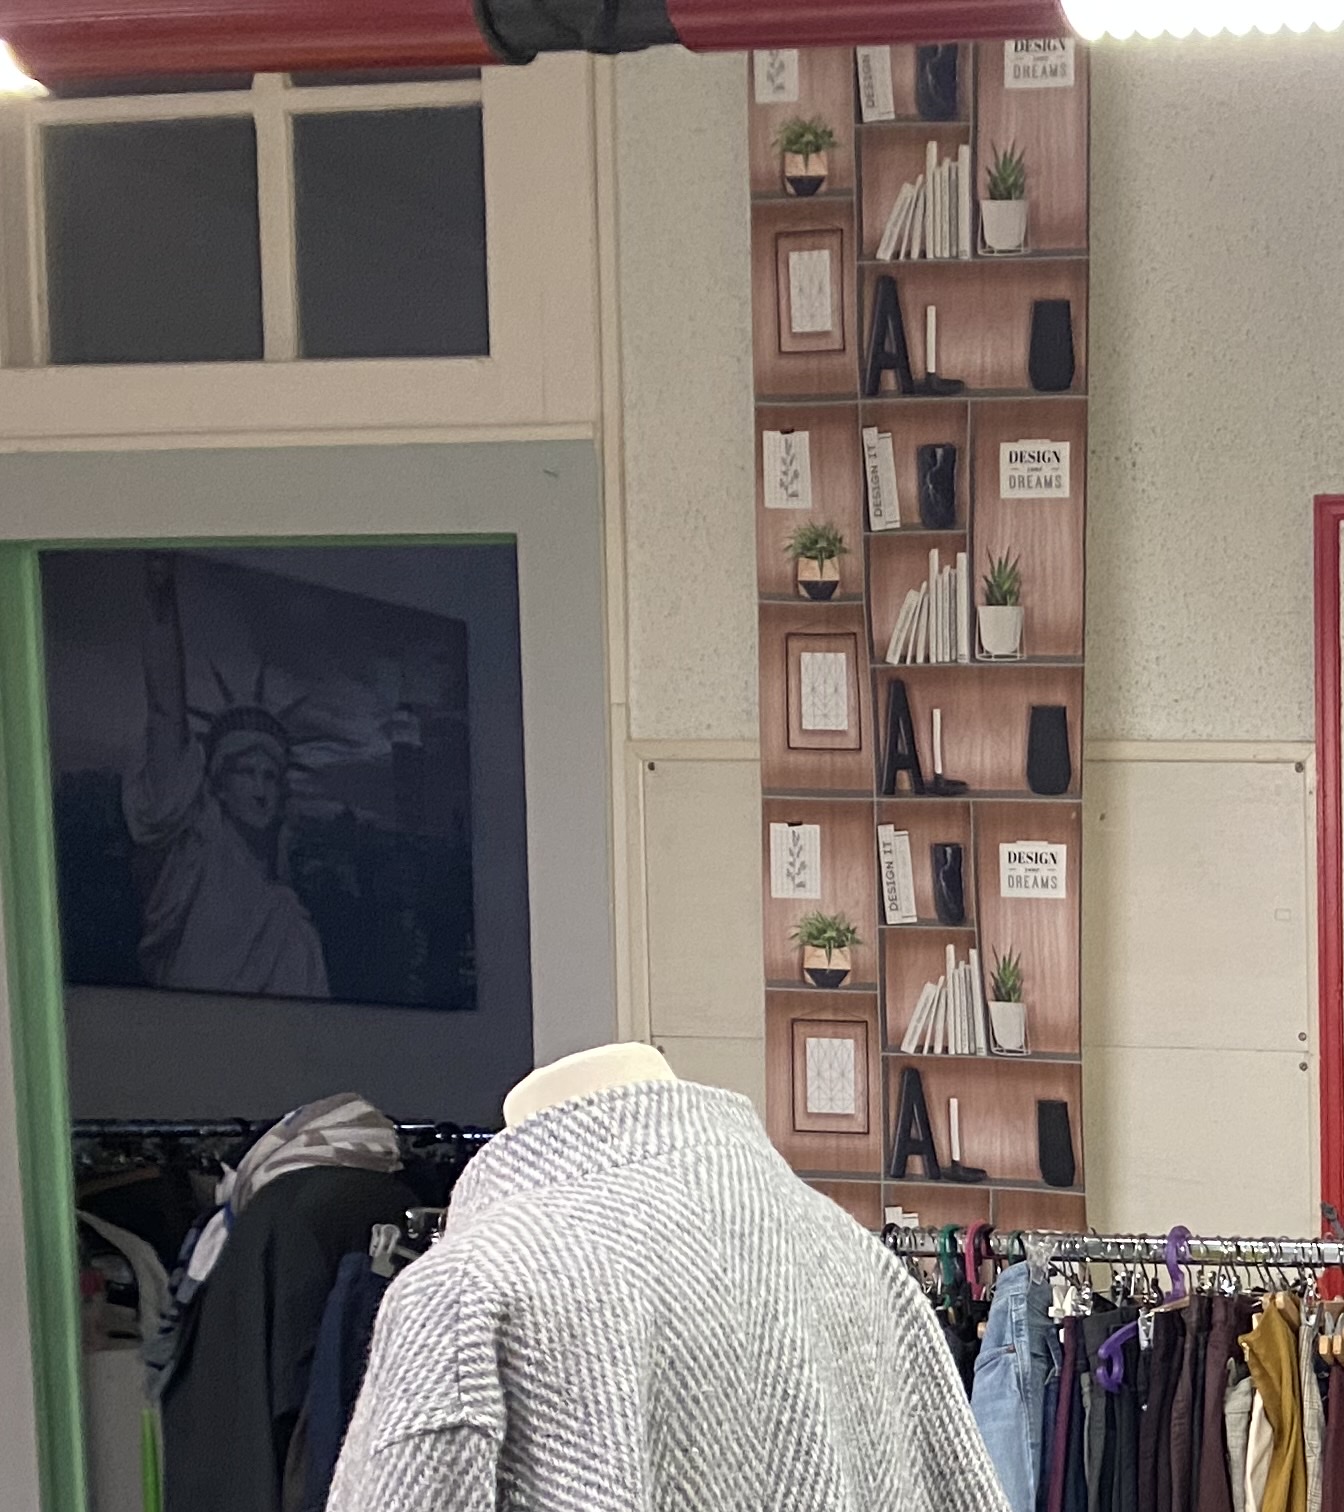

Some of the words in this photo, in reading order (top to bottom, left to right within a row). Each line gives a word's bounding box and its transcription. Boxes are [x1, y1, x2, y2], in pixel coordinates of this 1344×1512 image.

[1013, 39, 1067, 53] DESIGN
[1013, 62, 1067, 79] DREAMS
[867, 443, 878, 459] IT
[1008, 450, 1061, 464] DESIGN
[1008, 474, 1062, 489] DREAMS
[870, 465, 883, 518] DESIGN
[882, 841, 893, 855] IT
[1007, 851, 1058, 865] DESIGN
[885, 861, 899, 911] DESIGN
[1007, 874, 1058, 889] DREAMS
